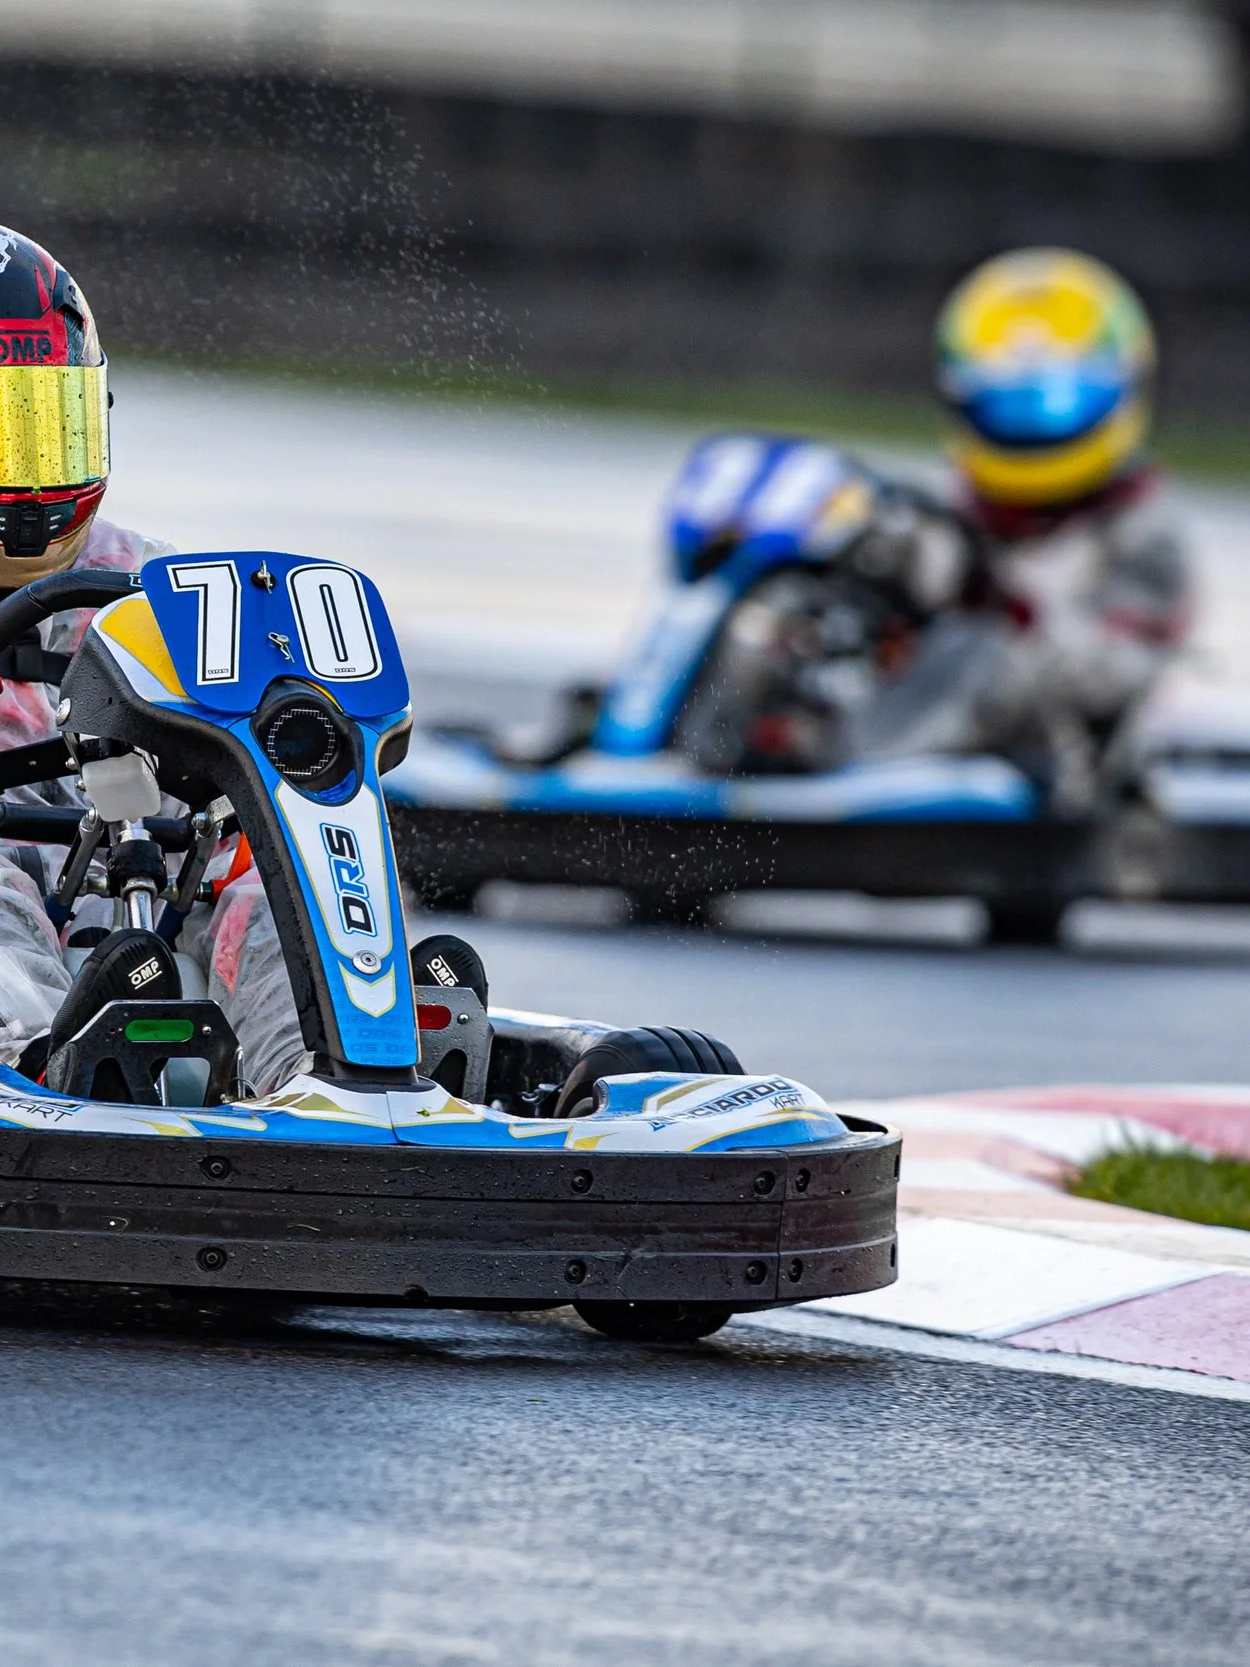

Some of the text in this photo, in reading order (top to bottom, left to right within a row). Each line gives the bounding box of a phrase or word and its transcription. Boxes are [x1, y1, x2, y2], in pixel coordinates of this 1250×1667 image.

[166, 559, 382, 685] 70
[321, 824, 376, 936] DRS
[130, 959, 160, 986] OMP
[430, 957, 456, 987] OMP
[768, 1093, 807, 1111] KART
